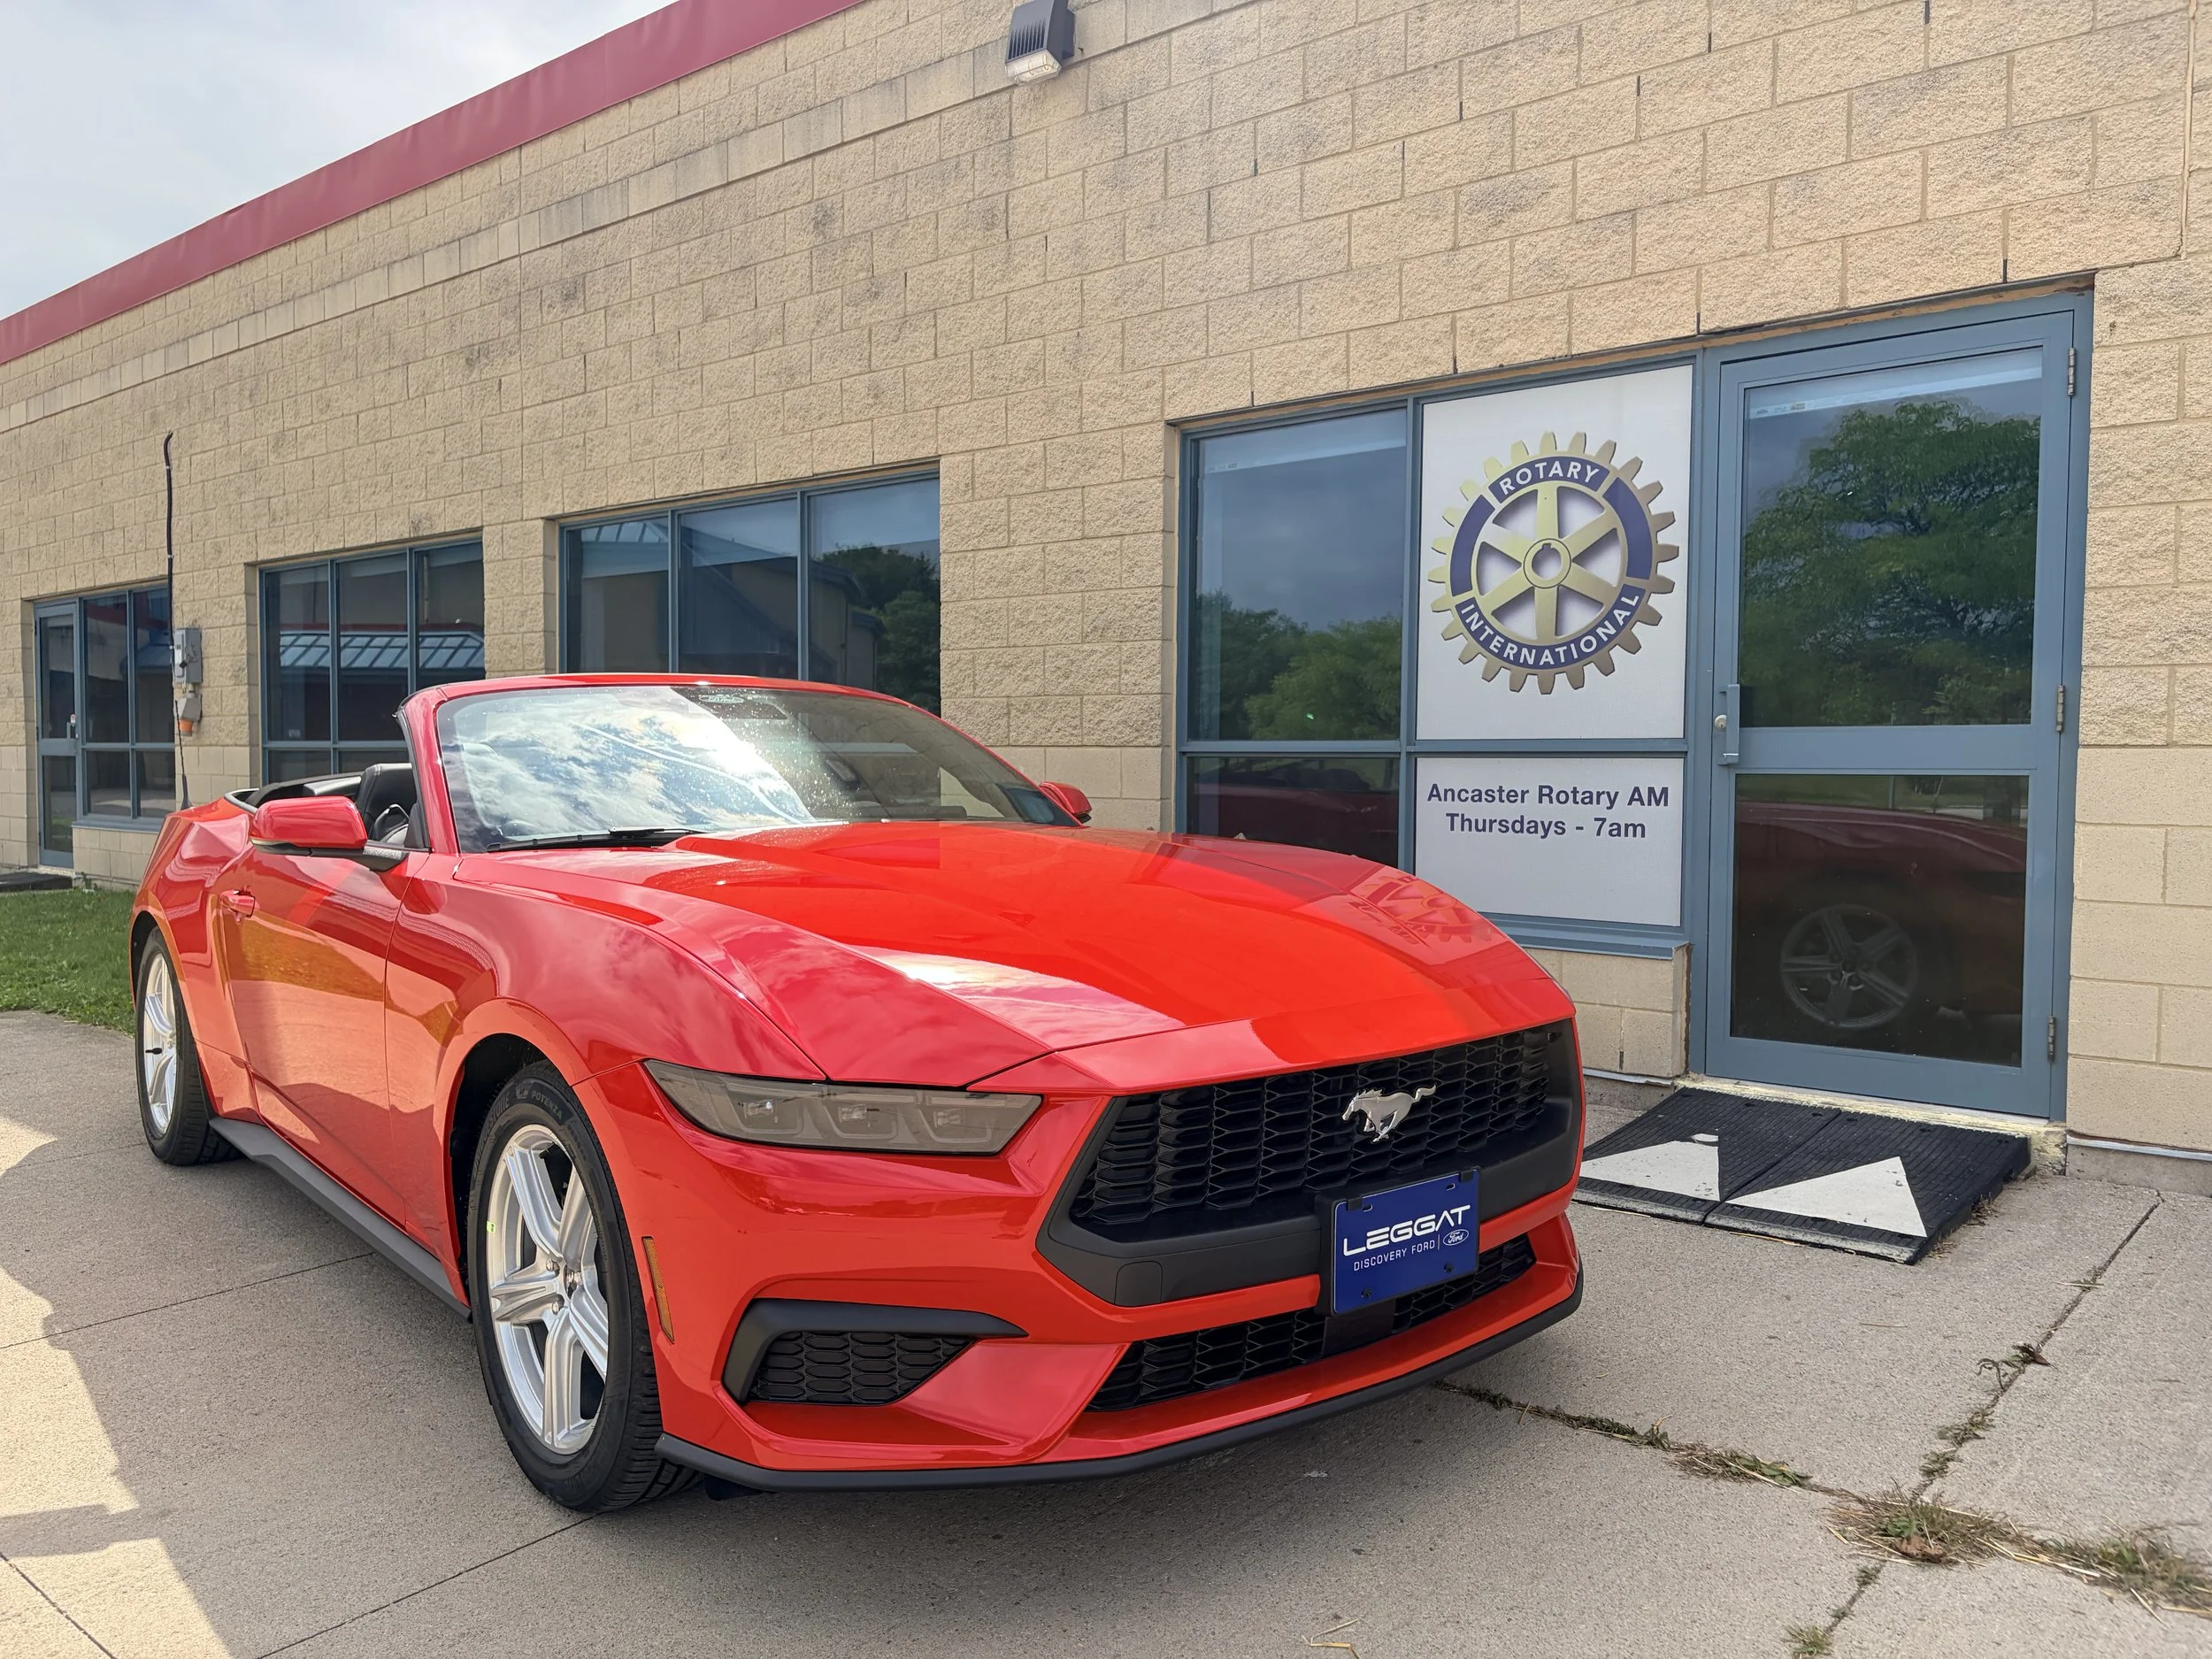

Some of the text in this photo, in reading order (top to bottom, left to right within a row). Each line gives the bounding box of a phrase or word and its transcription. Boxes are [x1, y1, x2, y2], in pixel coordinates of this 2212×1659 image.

[1500, 461, 1600, 495] ROTARY
[1461, 594, 1640, 665] INTERNATIONAL
[1427, 783, 1669, 810] Ancaster Rotary AM
[1446, 812, 1566, 839] Thursdays
[1594, 817, 1646, 838] 7am
[531, 1089, 563, 1120] POTENZA
[1343, 1204, 1471, 1256] LEGGAT
[1354, 1240, 1435, 1271] DISCOVERY FORD
